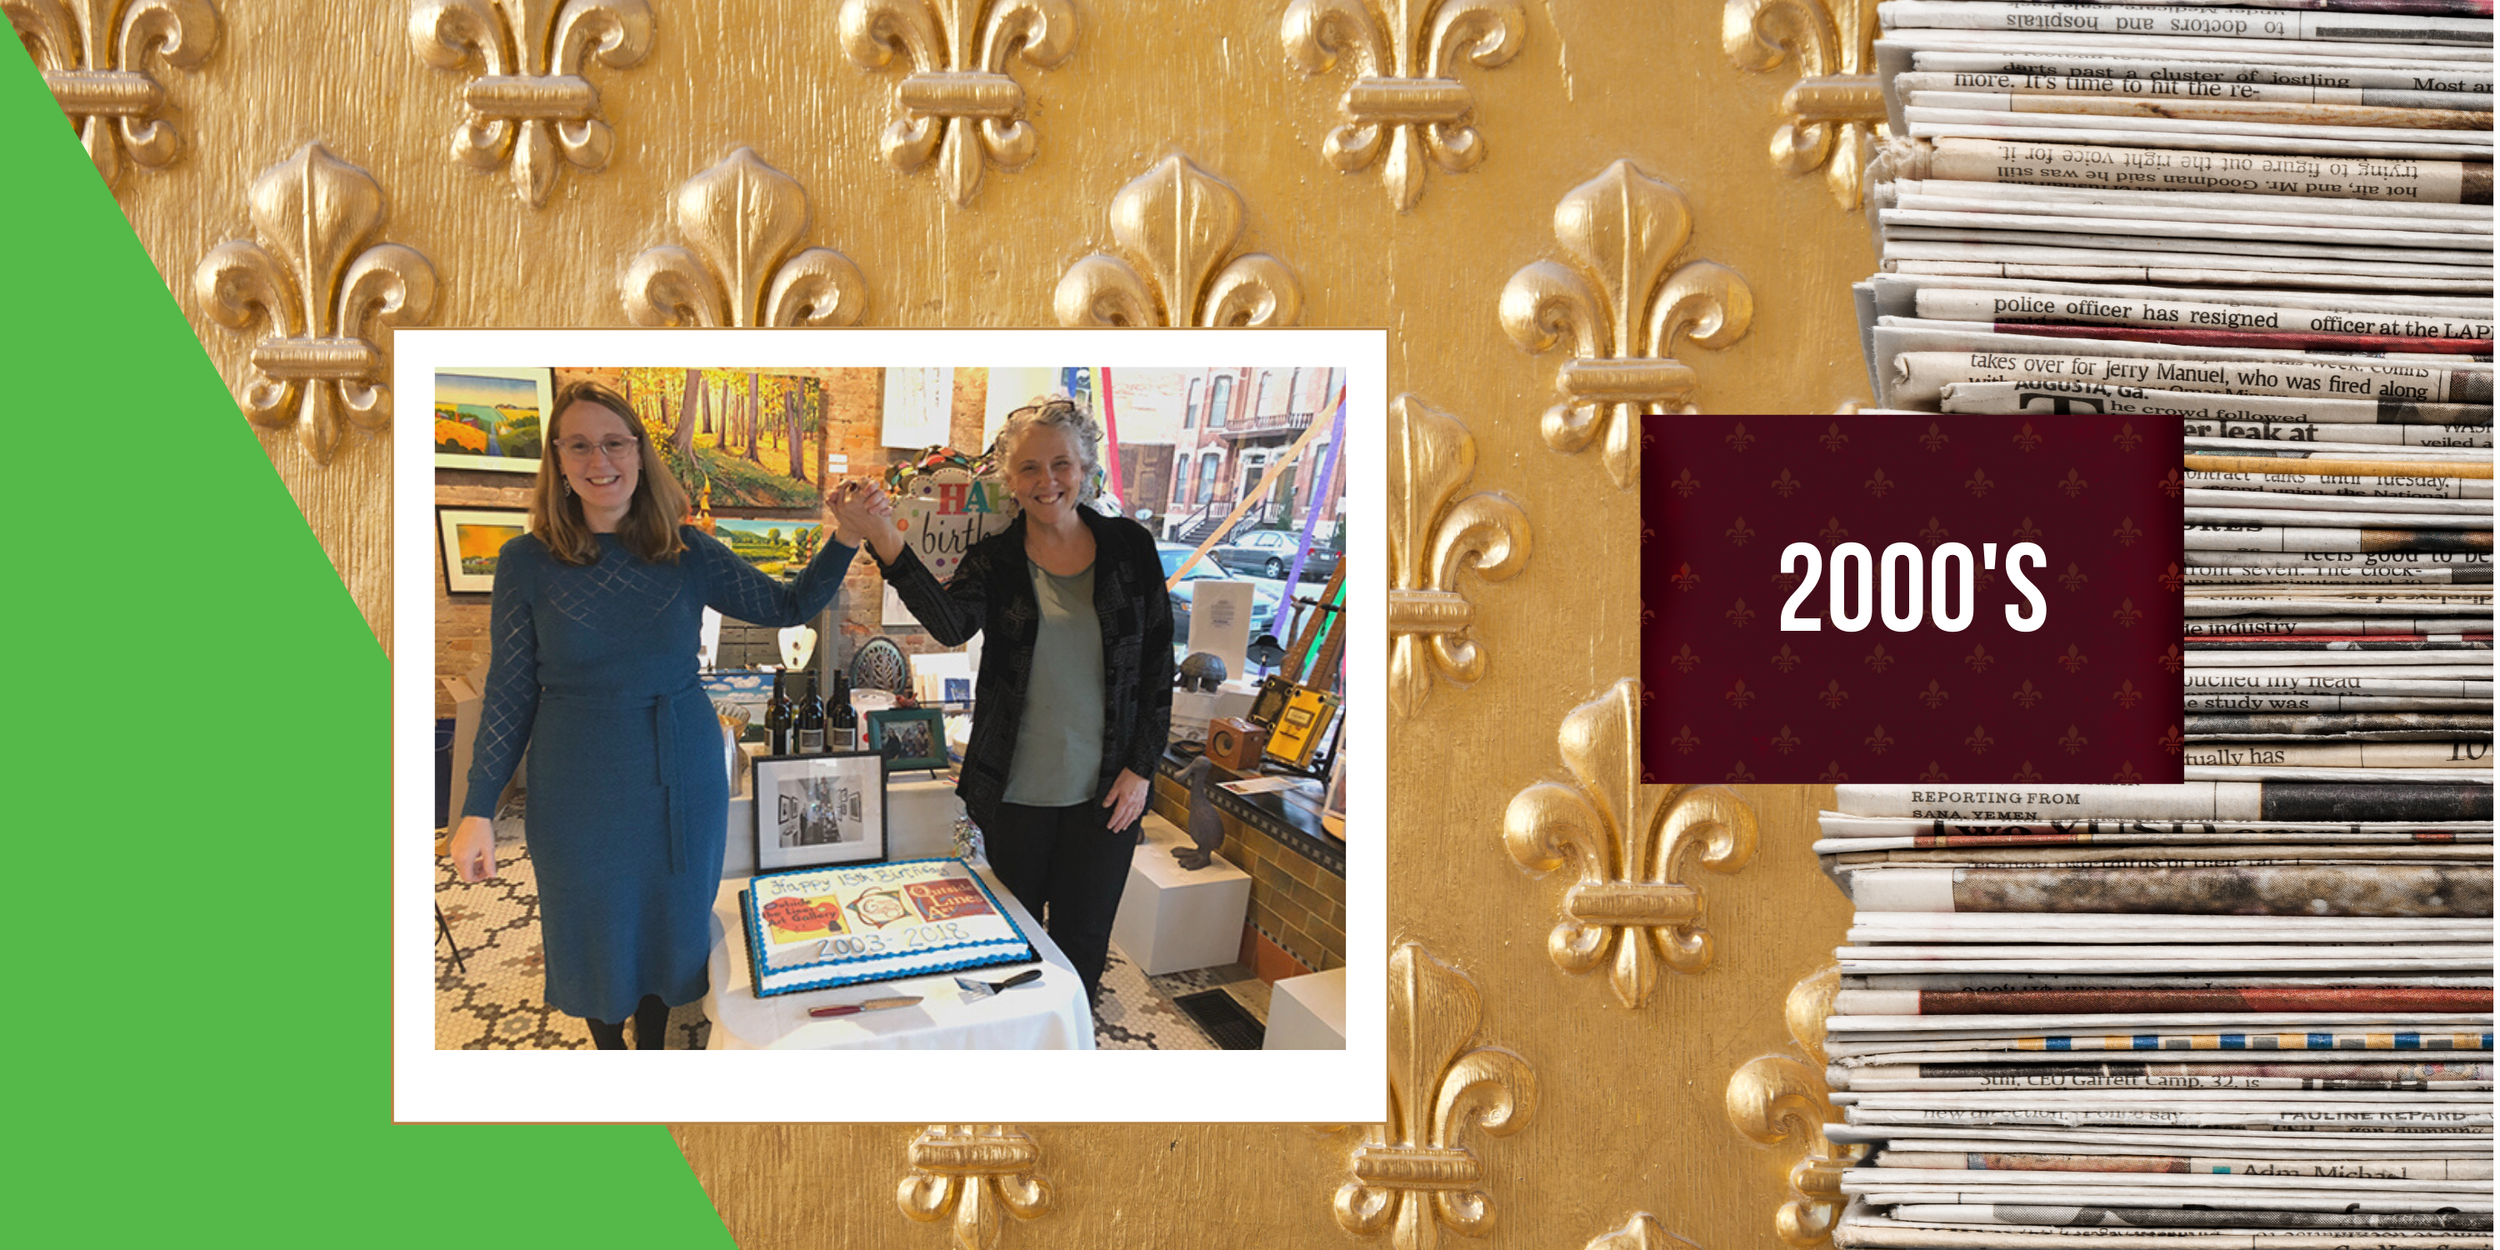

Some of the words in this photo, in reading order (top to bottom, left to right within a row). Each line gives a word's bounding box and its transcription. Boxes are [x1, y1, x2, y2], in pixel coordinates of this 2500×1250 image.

[2006, 12, 2099, 31] hospitals
[2116, 17, 2154, 31] and
[2170, 18, 2247, 35] doctors
[2265, 20, 2285, 36] to
[2003, 62, 2057, 74] darts
[2070, 67, 2114, 77] past
[2126, 69, 2138, 78] a
[2150, 67, 2223, 82] cluster
[2236, 70, 2258, 82] of
[2270, 73, 2350, 88] jostling
[1954, 73, 2015, 88] more.
[2024, 75, 2057, 90] It's
[2065, 76, 2114, 91] time
[2123, 77, 2142, 93] to
[2151, 79, 2179, 95] hit
[2188, 81, 2221, 97] the
[2229, 84, 2260, 98] re-
[2413, 77, 2466, 91] Most
[1998, 146, 2016, 163] it.
[2025, 147, 2053, 164] for
[2062, 149, 2114, 165] voice
[2124, 151, 2171, 171] right
[1998, 166, 2033, 177] still
[2181, 156, 2211, 171] the
[2222, 158, 2252, 171] out
[2263, 159, 2320, 178] figure
[2330, 163, 2348, 177] to
[2358, 162, 2418, 180] trying
[2040, 168, 2078, 178] was
[2086, 170, 2109, 181] he
[2116, 172, 2156, 183] said
[2163, 174, 2258, 190] Goodman
[2265, 181, 2298, 192] Mr.
[2306, 182, 2342, 193] and
[2349, 182, 2379, 195] air,
[2386, 185, 2418, 198] hot
[1994, 297, 2055, 314] police
[2066, 301, 2132, 318] officer
[2142, 304, 2179, 322] has
[2190, 309, 2278, 329] resigned
[2310, 315, 2376, 334] officer
[2379, 320, 2401, 336] at
[2405, 321, 2439, 338] the
[2443, 323, 2493, 340] LAP
[1971, 353, 2016, 370] takes
[2024, 358, 2064, 374] over
[2071, 357, 2096, 375] for
[2102, 360, 2149, 382] Jerry
[2157, 363, 2230, 386] Manuel,
[2238, 368, 2278, 387] who
[2286, 375, 2321, 391] was
[2329, 375, 2371, 394] fired
[2379, 380, 2429, 401] along
[2014, 380, 2111, 397] AUGUSTA,
[2117, 386, 2149, 400] Ga.
[2110, 400, 2136, 412] he
[2142, 404, 2209, 418] crowd
[2215, 409, 2308, 423] followed
[2220, 421, 2282, 442] leak
[2289, 423, 2319, 442] at
[2420, 437, 2474, 448] veiled
[2184, 471, 2251, 482] ontract
[936, 481, 1010, 515] HAP
[2208, 621, 2297, 635] industry
[2204, 695, 2263, 710] study
[2267, 699, 2309, 709] was
[2184, 750, 2244, 767] tually
[2250, 748, 2284, 764] has
[1911, 791, 2022, 805] REPORTING
[2027, 792, 2080, 805] FROM
[1972, 810, 2037, 821] YEMEN
[770, 877, 830, 895] Happy
[837, 871, 873, 887] 15th
[875, 865, 950, 883] Birthday
[903, 922, 969, 947] 2018
[2280, 1112, 2374, 1121] PAULINE
